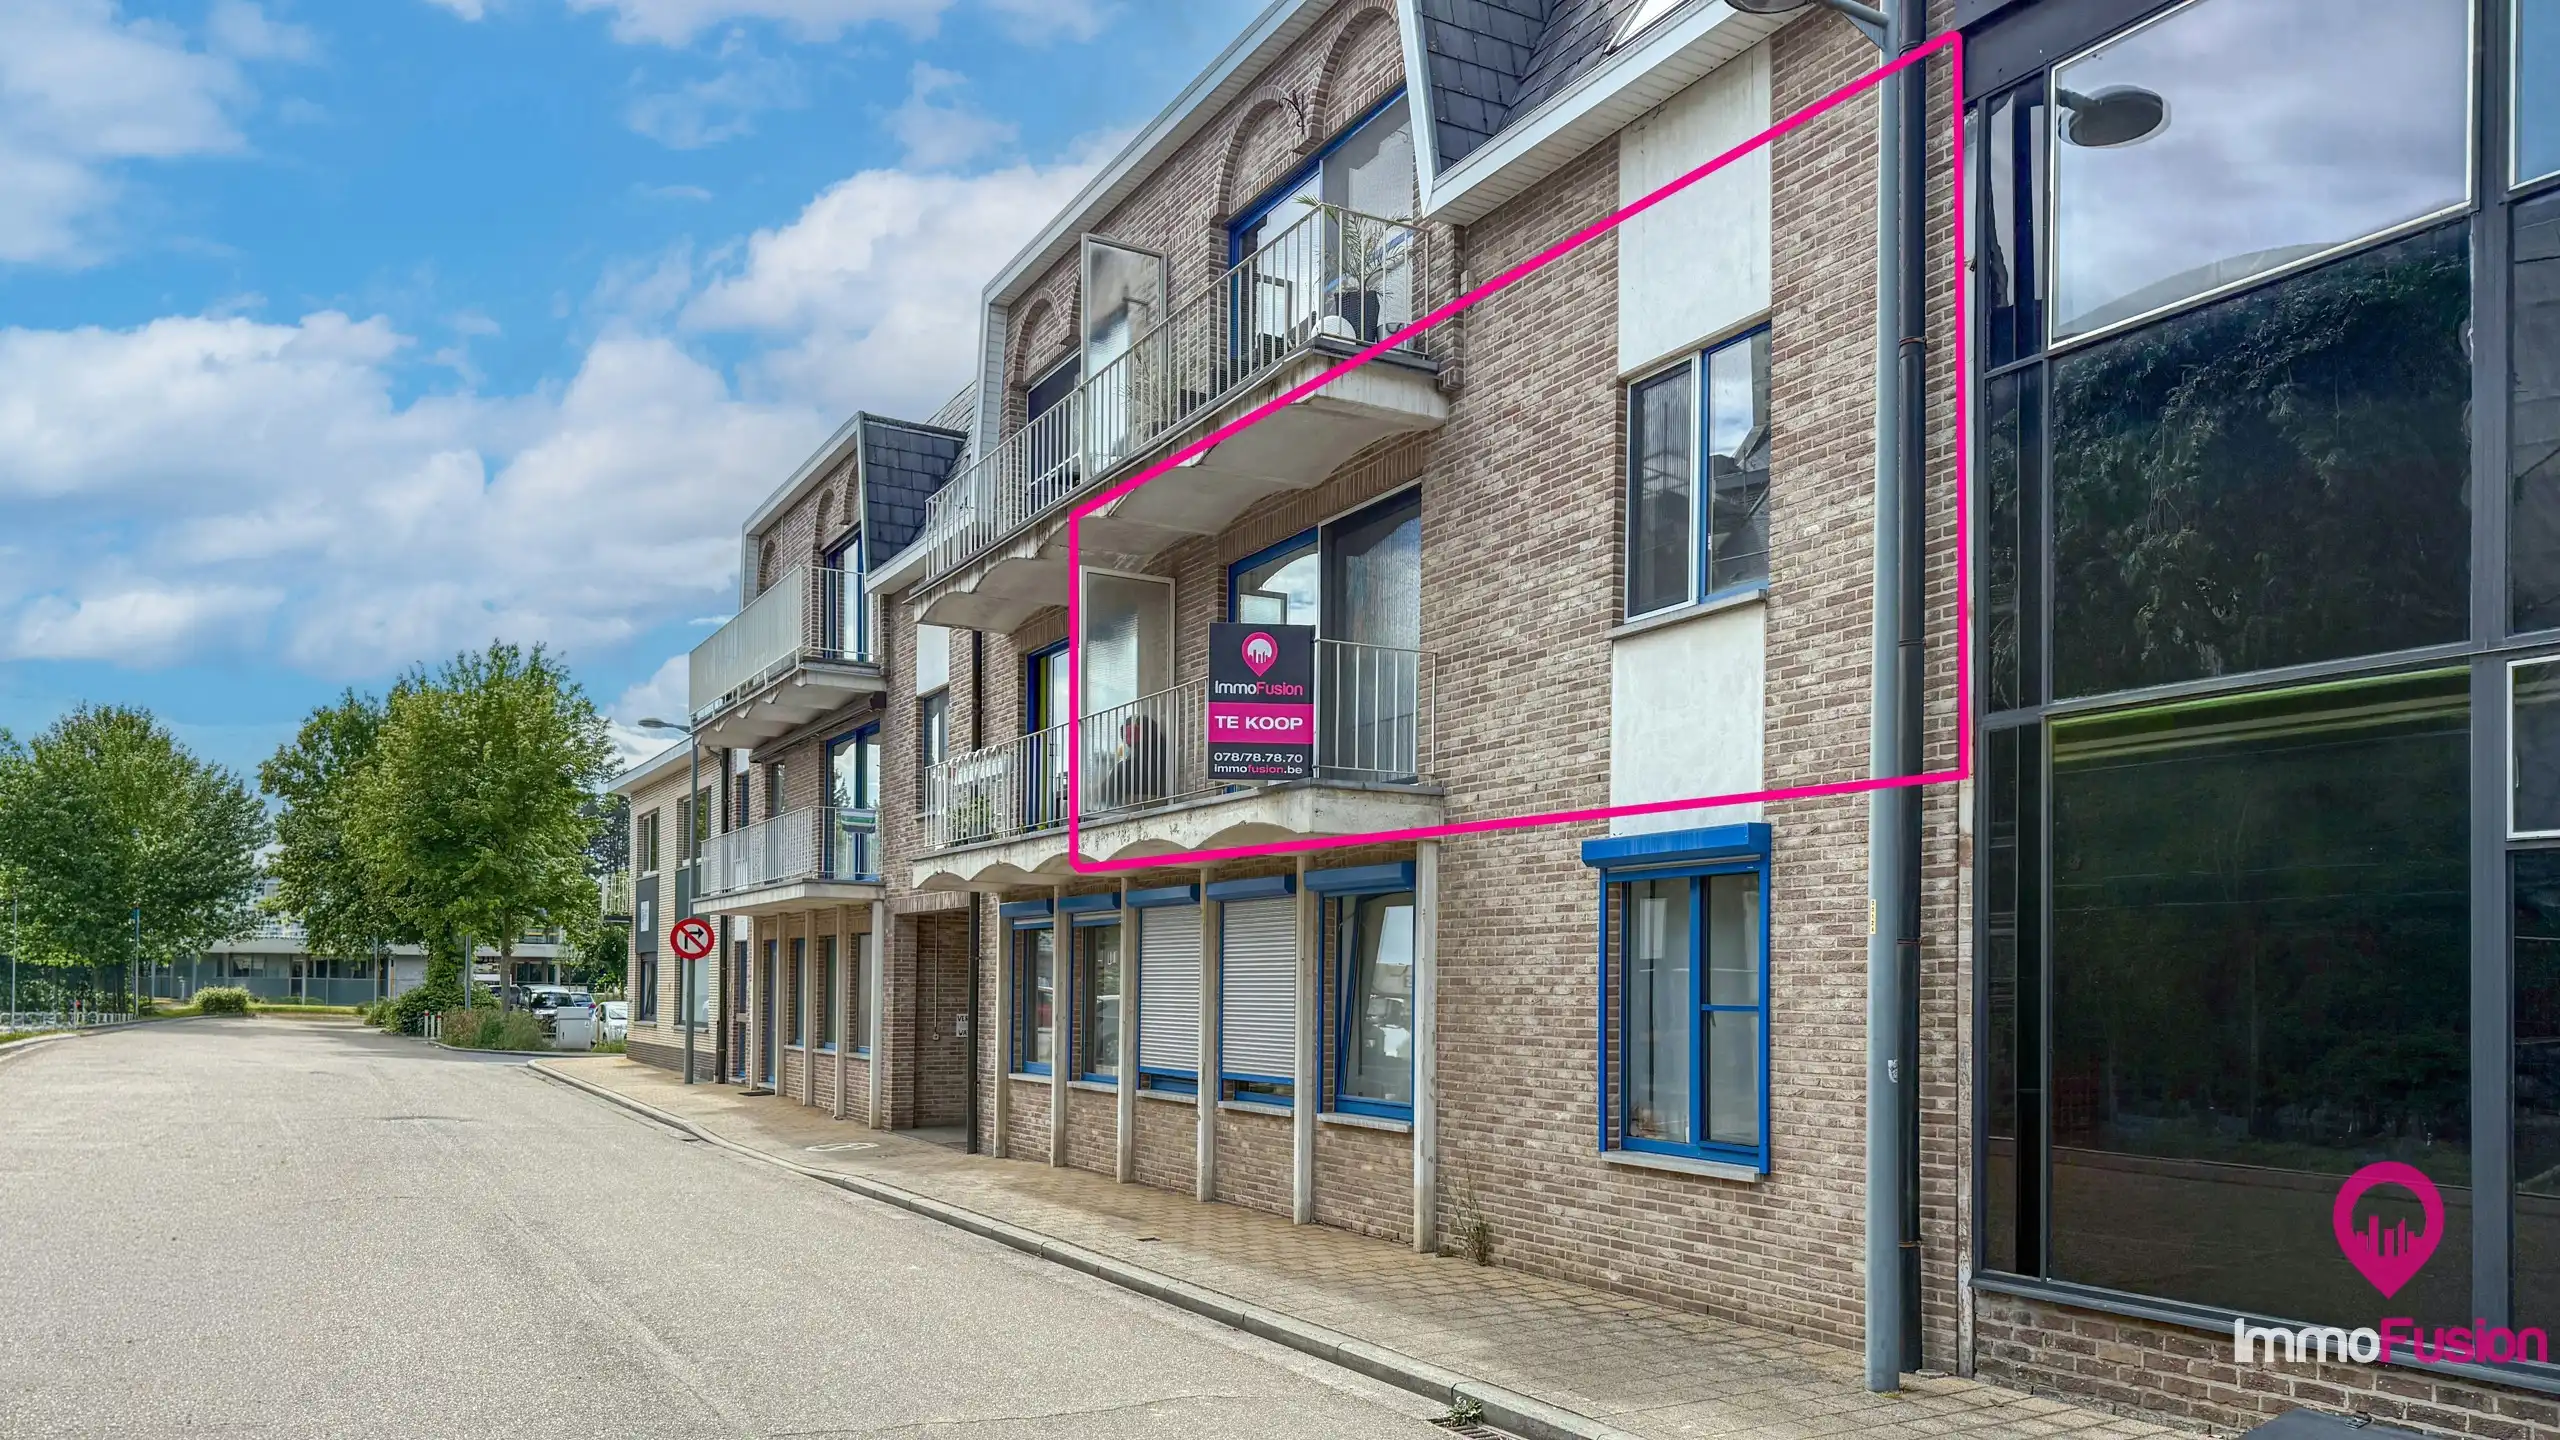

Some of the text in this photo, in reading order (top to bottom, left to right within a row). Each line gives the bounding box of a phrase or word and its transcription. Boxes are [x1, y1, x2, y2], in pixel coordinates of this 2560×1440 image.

[1214, 680, 1303, 695] ImmoFusion
[1214, 715, 1303, 730] TE KOOP
[1214, 752, 1303, 763] 078/78.78.70
